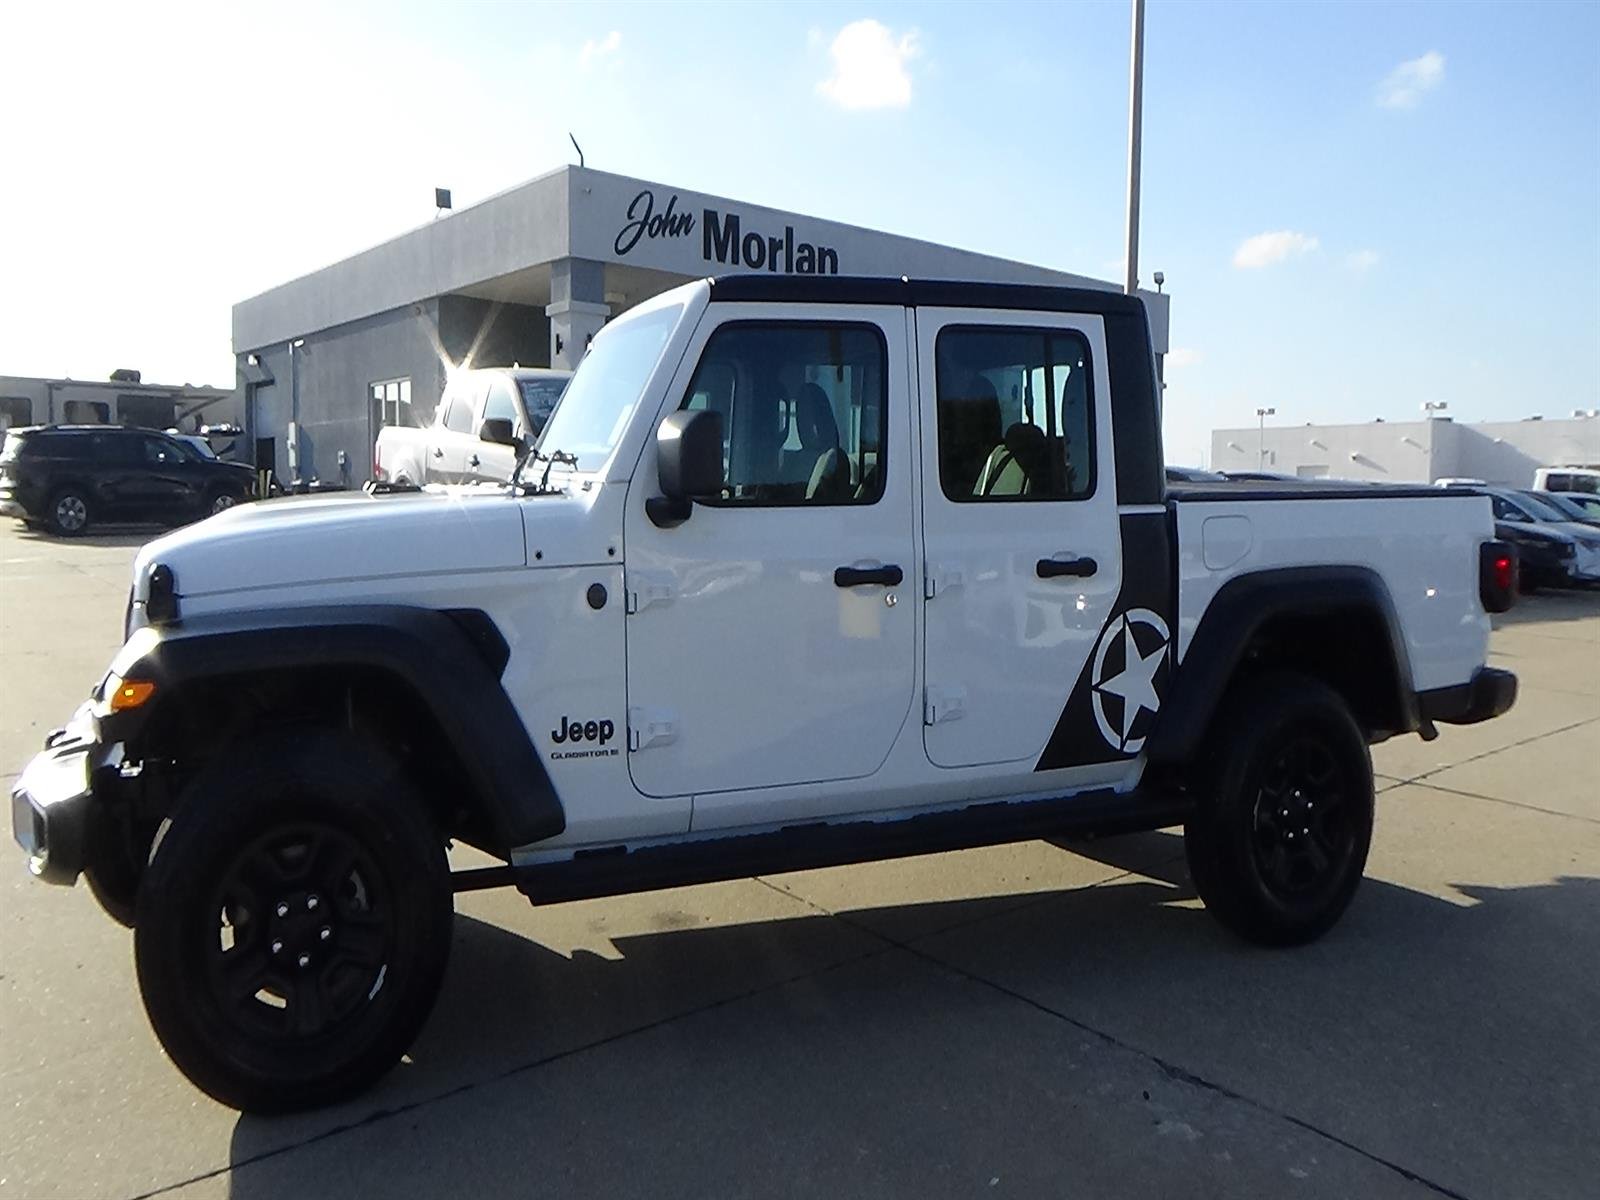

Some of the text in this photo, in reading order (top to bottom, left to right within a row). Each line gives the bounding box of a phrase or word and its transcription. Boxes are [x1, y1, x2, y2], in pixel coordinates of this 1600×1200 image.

[614, 190, 839, 275] John Morlan
[551, 716, 614, 745] Jeep
